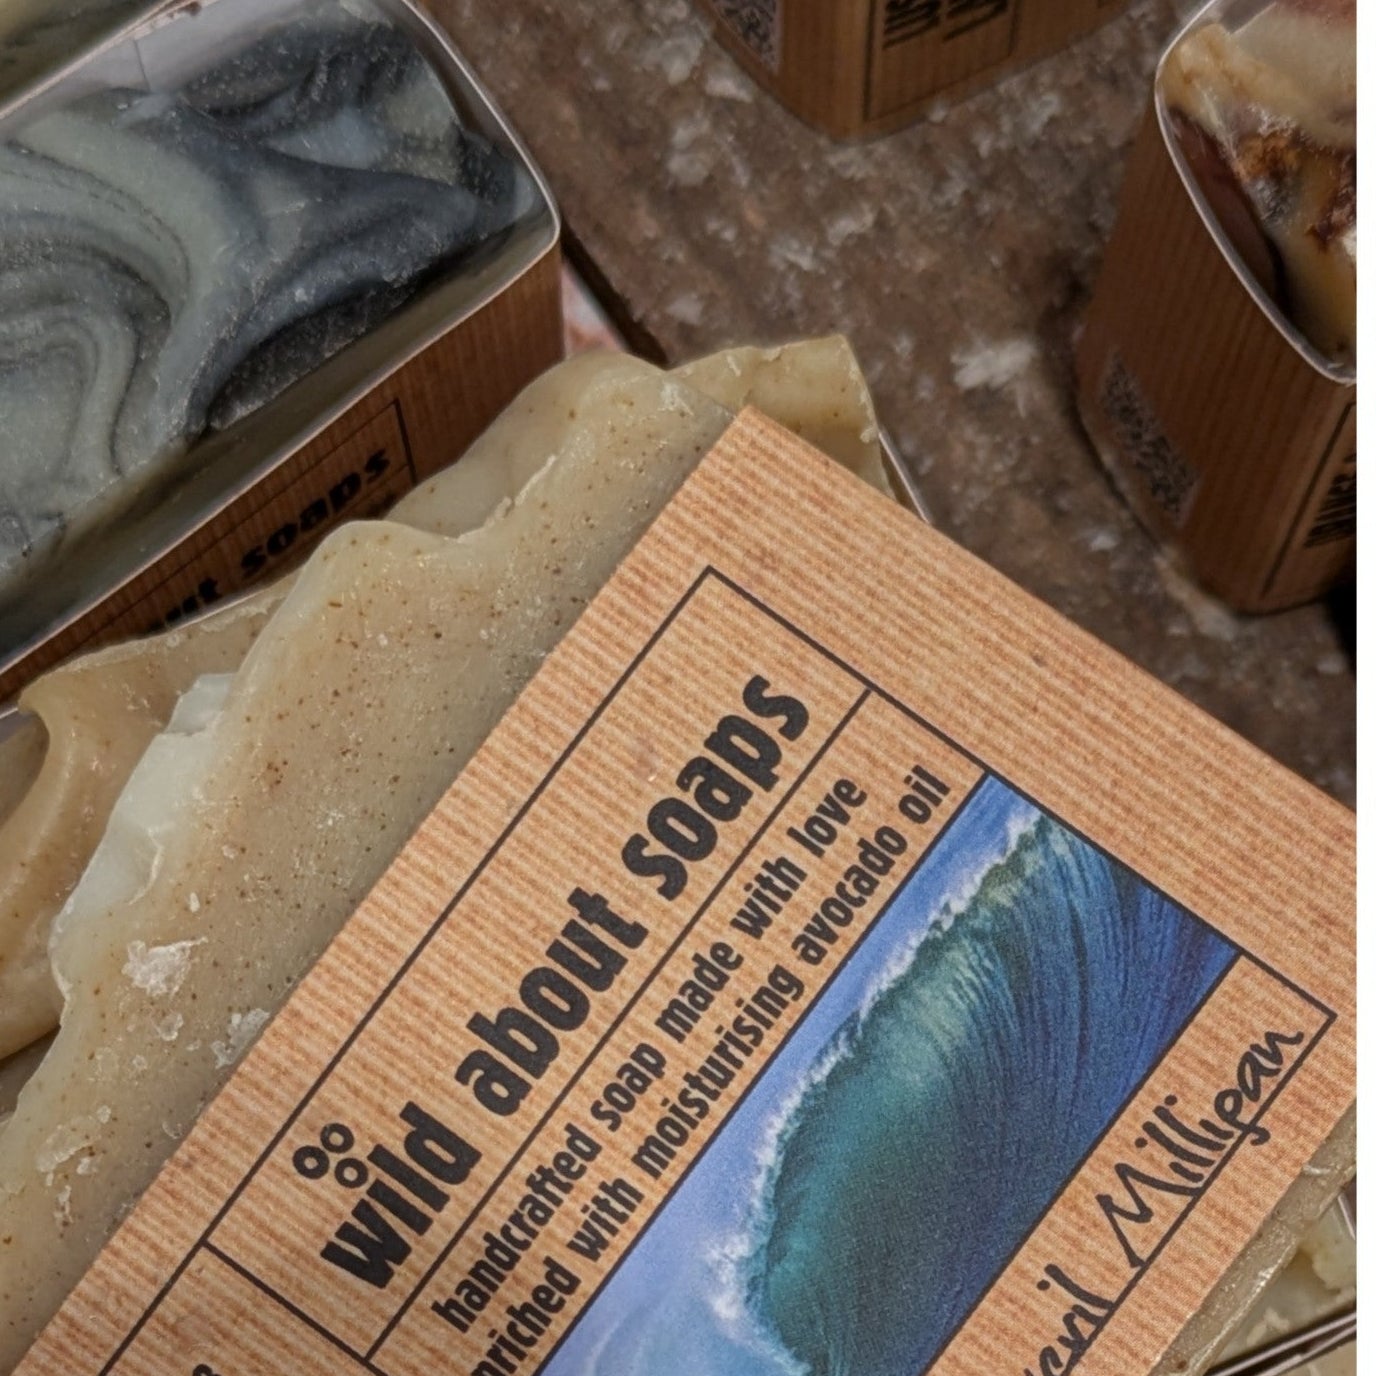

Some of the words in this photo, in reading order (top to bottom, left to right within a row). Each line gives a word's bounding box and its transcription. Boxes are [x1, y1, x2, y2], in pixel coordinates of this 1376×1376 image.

[319, 1101, 483, 1290] wild
[455, 886, 649, 1117] about
[621, 674, 810, 900] soaps
[431, 1123, 601, 1334] handcrafted
[590, 1042, 668, 1133] soap
[654, 942, 744, 1044] made
[731, 854, 808, 938] with
[789, 775, 869, 859] love
[565, 1176, 645, 1264] with
[631, 964, 804, 1180] moisturising
[789, 826, 910, 968] avocado
[896, 765, 953, 826] oil
